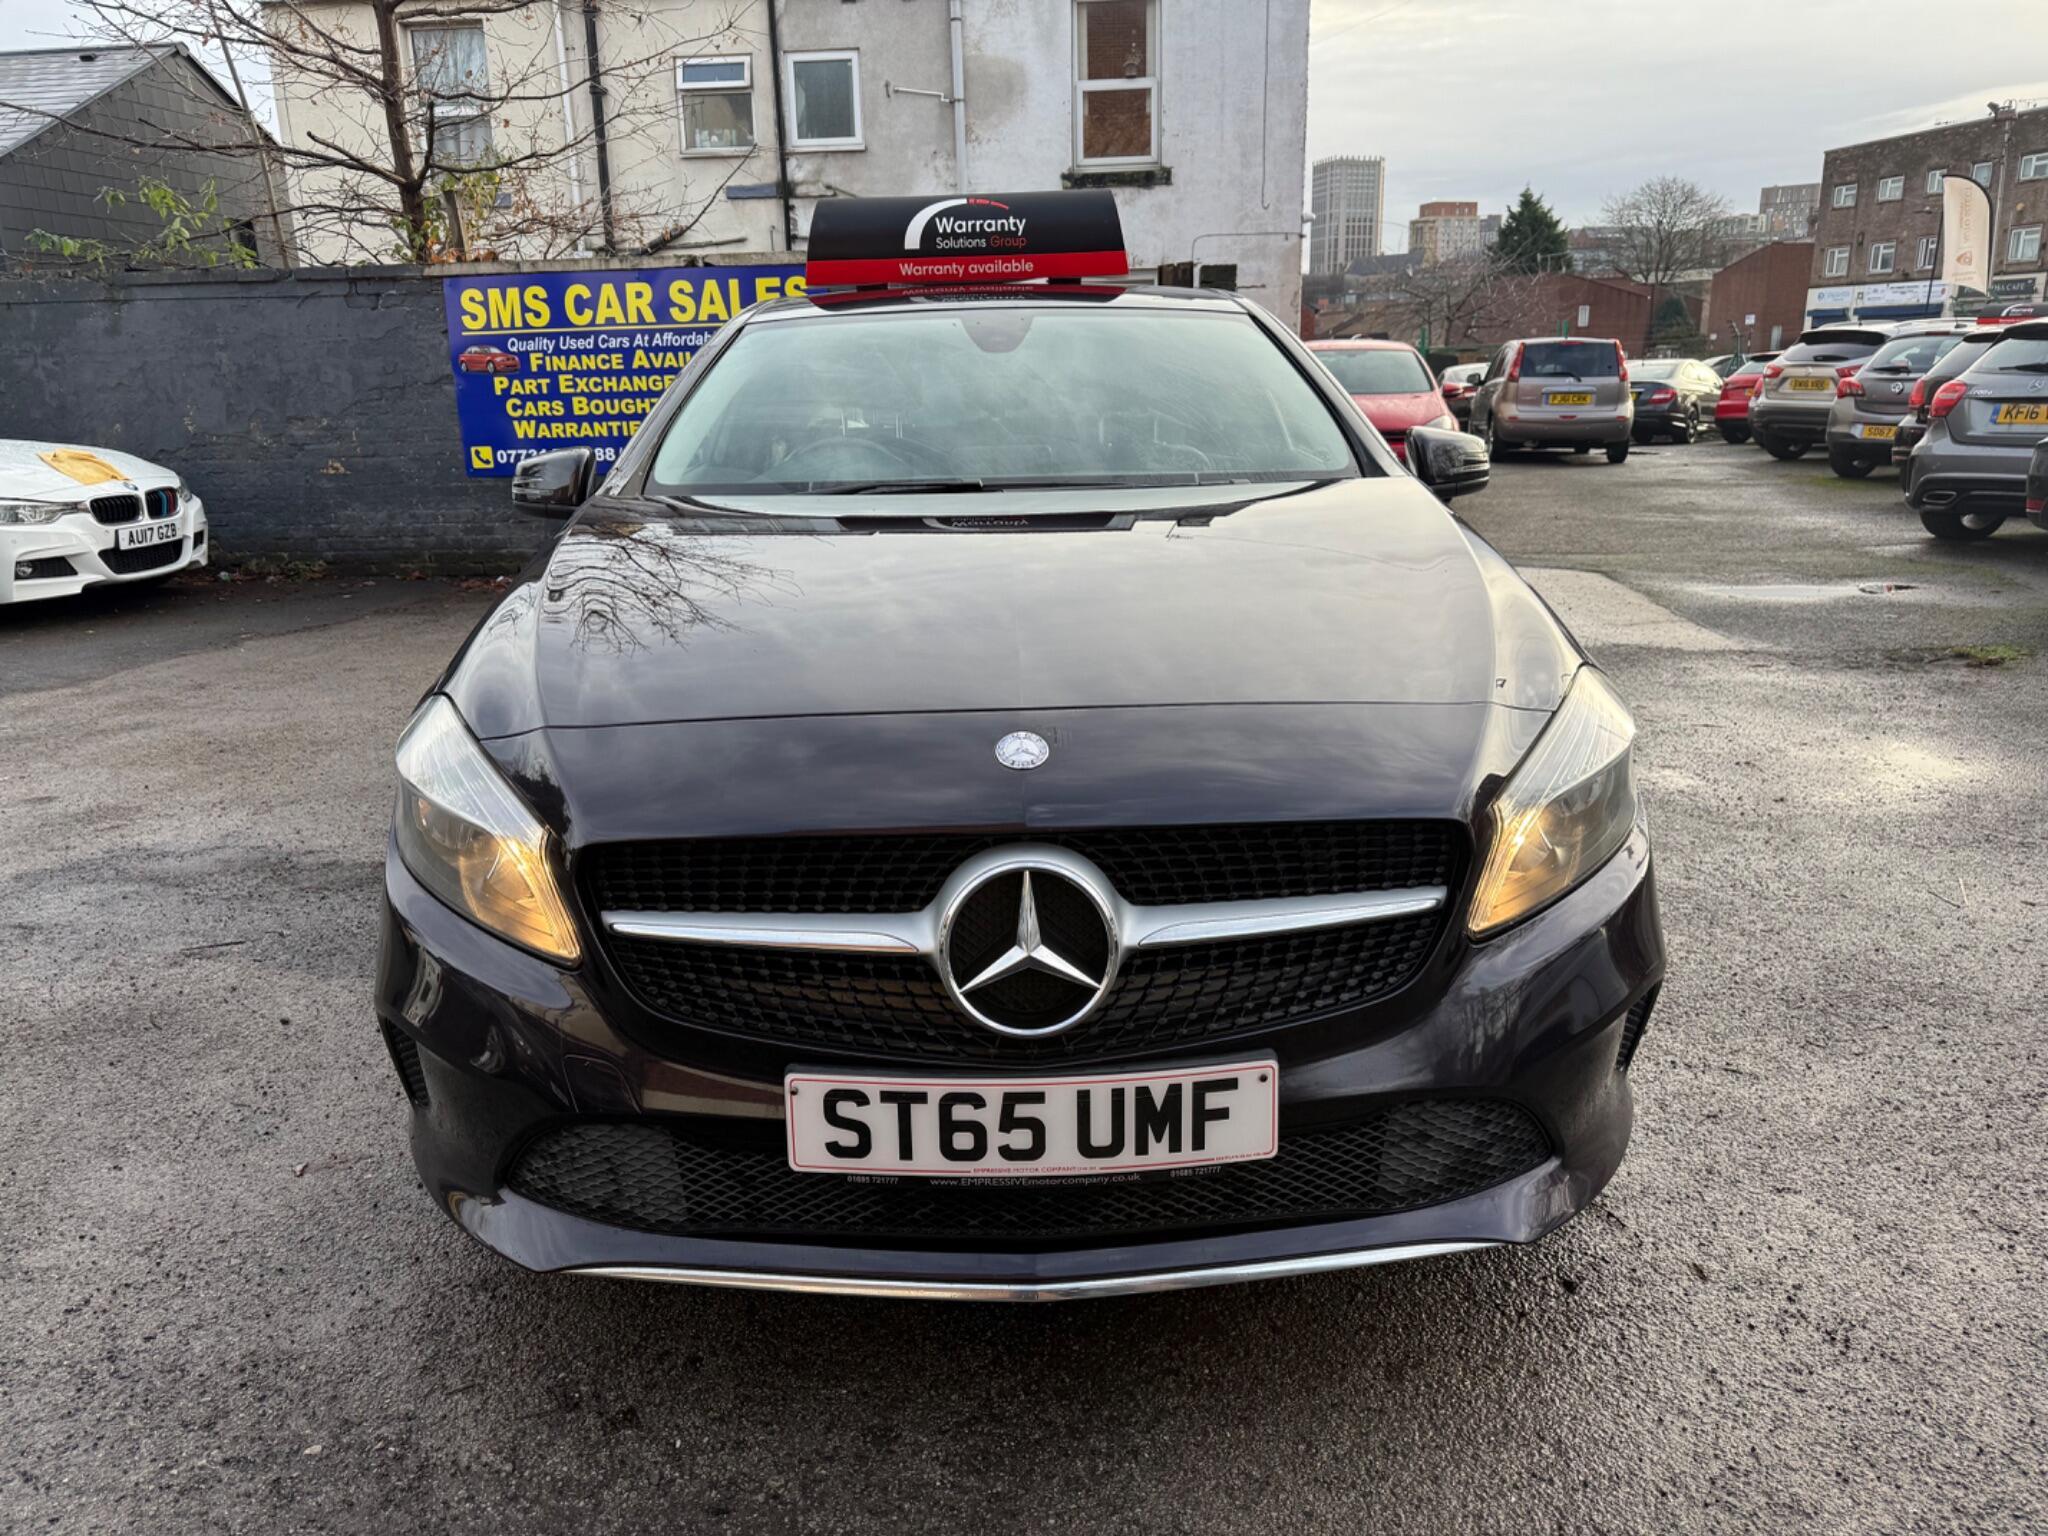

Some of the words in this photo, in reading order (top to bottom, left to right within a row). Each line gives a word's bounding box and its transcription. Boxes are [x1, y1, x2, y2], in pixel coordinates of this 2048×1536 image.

[935, 215, 1026, 236] Warranty
[936, 236, 987, 249] Solutions
[990, 235, 1027, 249] Group
[899, 262, 965, 278] Warranty
[968, 259, 1034, 273] available
[460, 285, 551, 331] SMS
[564, 282, 657, 326] CAR
[507, 337, 556, 354] Quality
[560, 335, 594, 350] Used
[597, 334, 630, 348] Cars
[633, 333, 649, 348] At
[652, 331, 716, 347] Affordab
[529, 352, 625, 372] FINANCE
[494, 376, 550, 395] PART
[506, 398, 565, 417] CARS
[2003, 403, 2039, 420] KF16
[128, 527, 154, 546] AU17
[157, 522, 177, 540] GZB
[822, 1088, 1046, 1162] ST65
[1076, 1077, 1239, 1159] UMF
